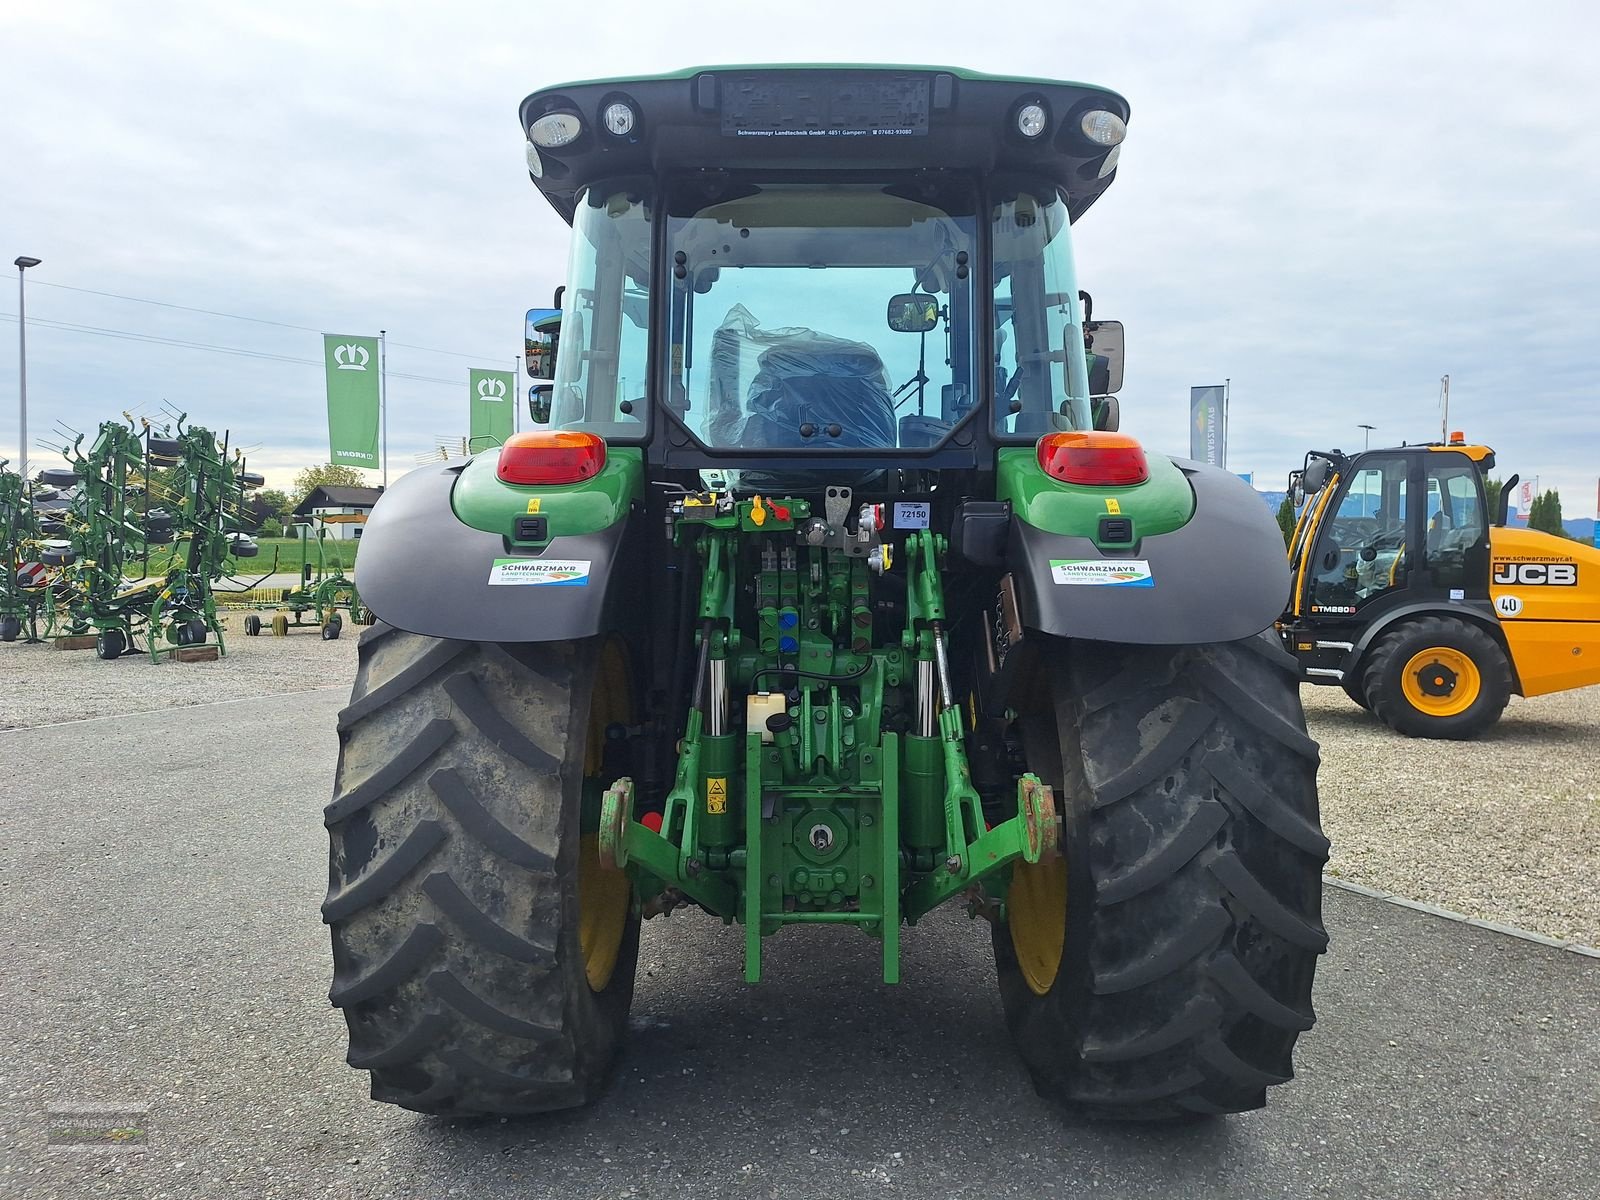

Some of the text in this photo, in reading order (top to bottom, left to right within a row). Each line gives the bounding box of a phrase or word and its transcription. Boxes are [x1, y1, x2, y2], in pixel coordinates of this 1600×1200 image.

[901, 510, 927, 518] 72150
[1494, 564, 1576, 585] JCB
[1501, 598, 1517, 611] 40
